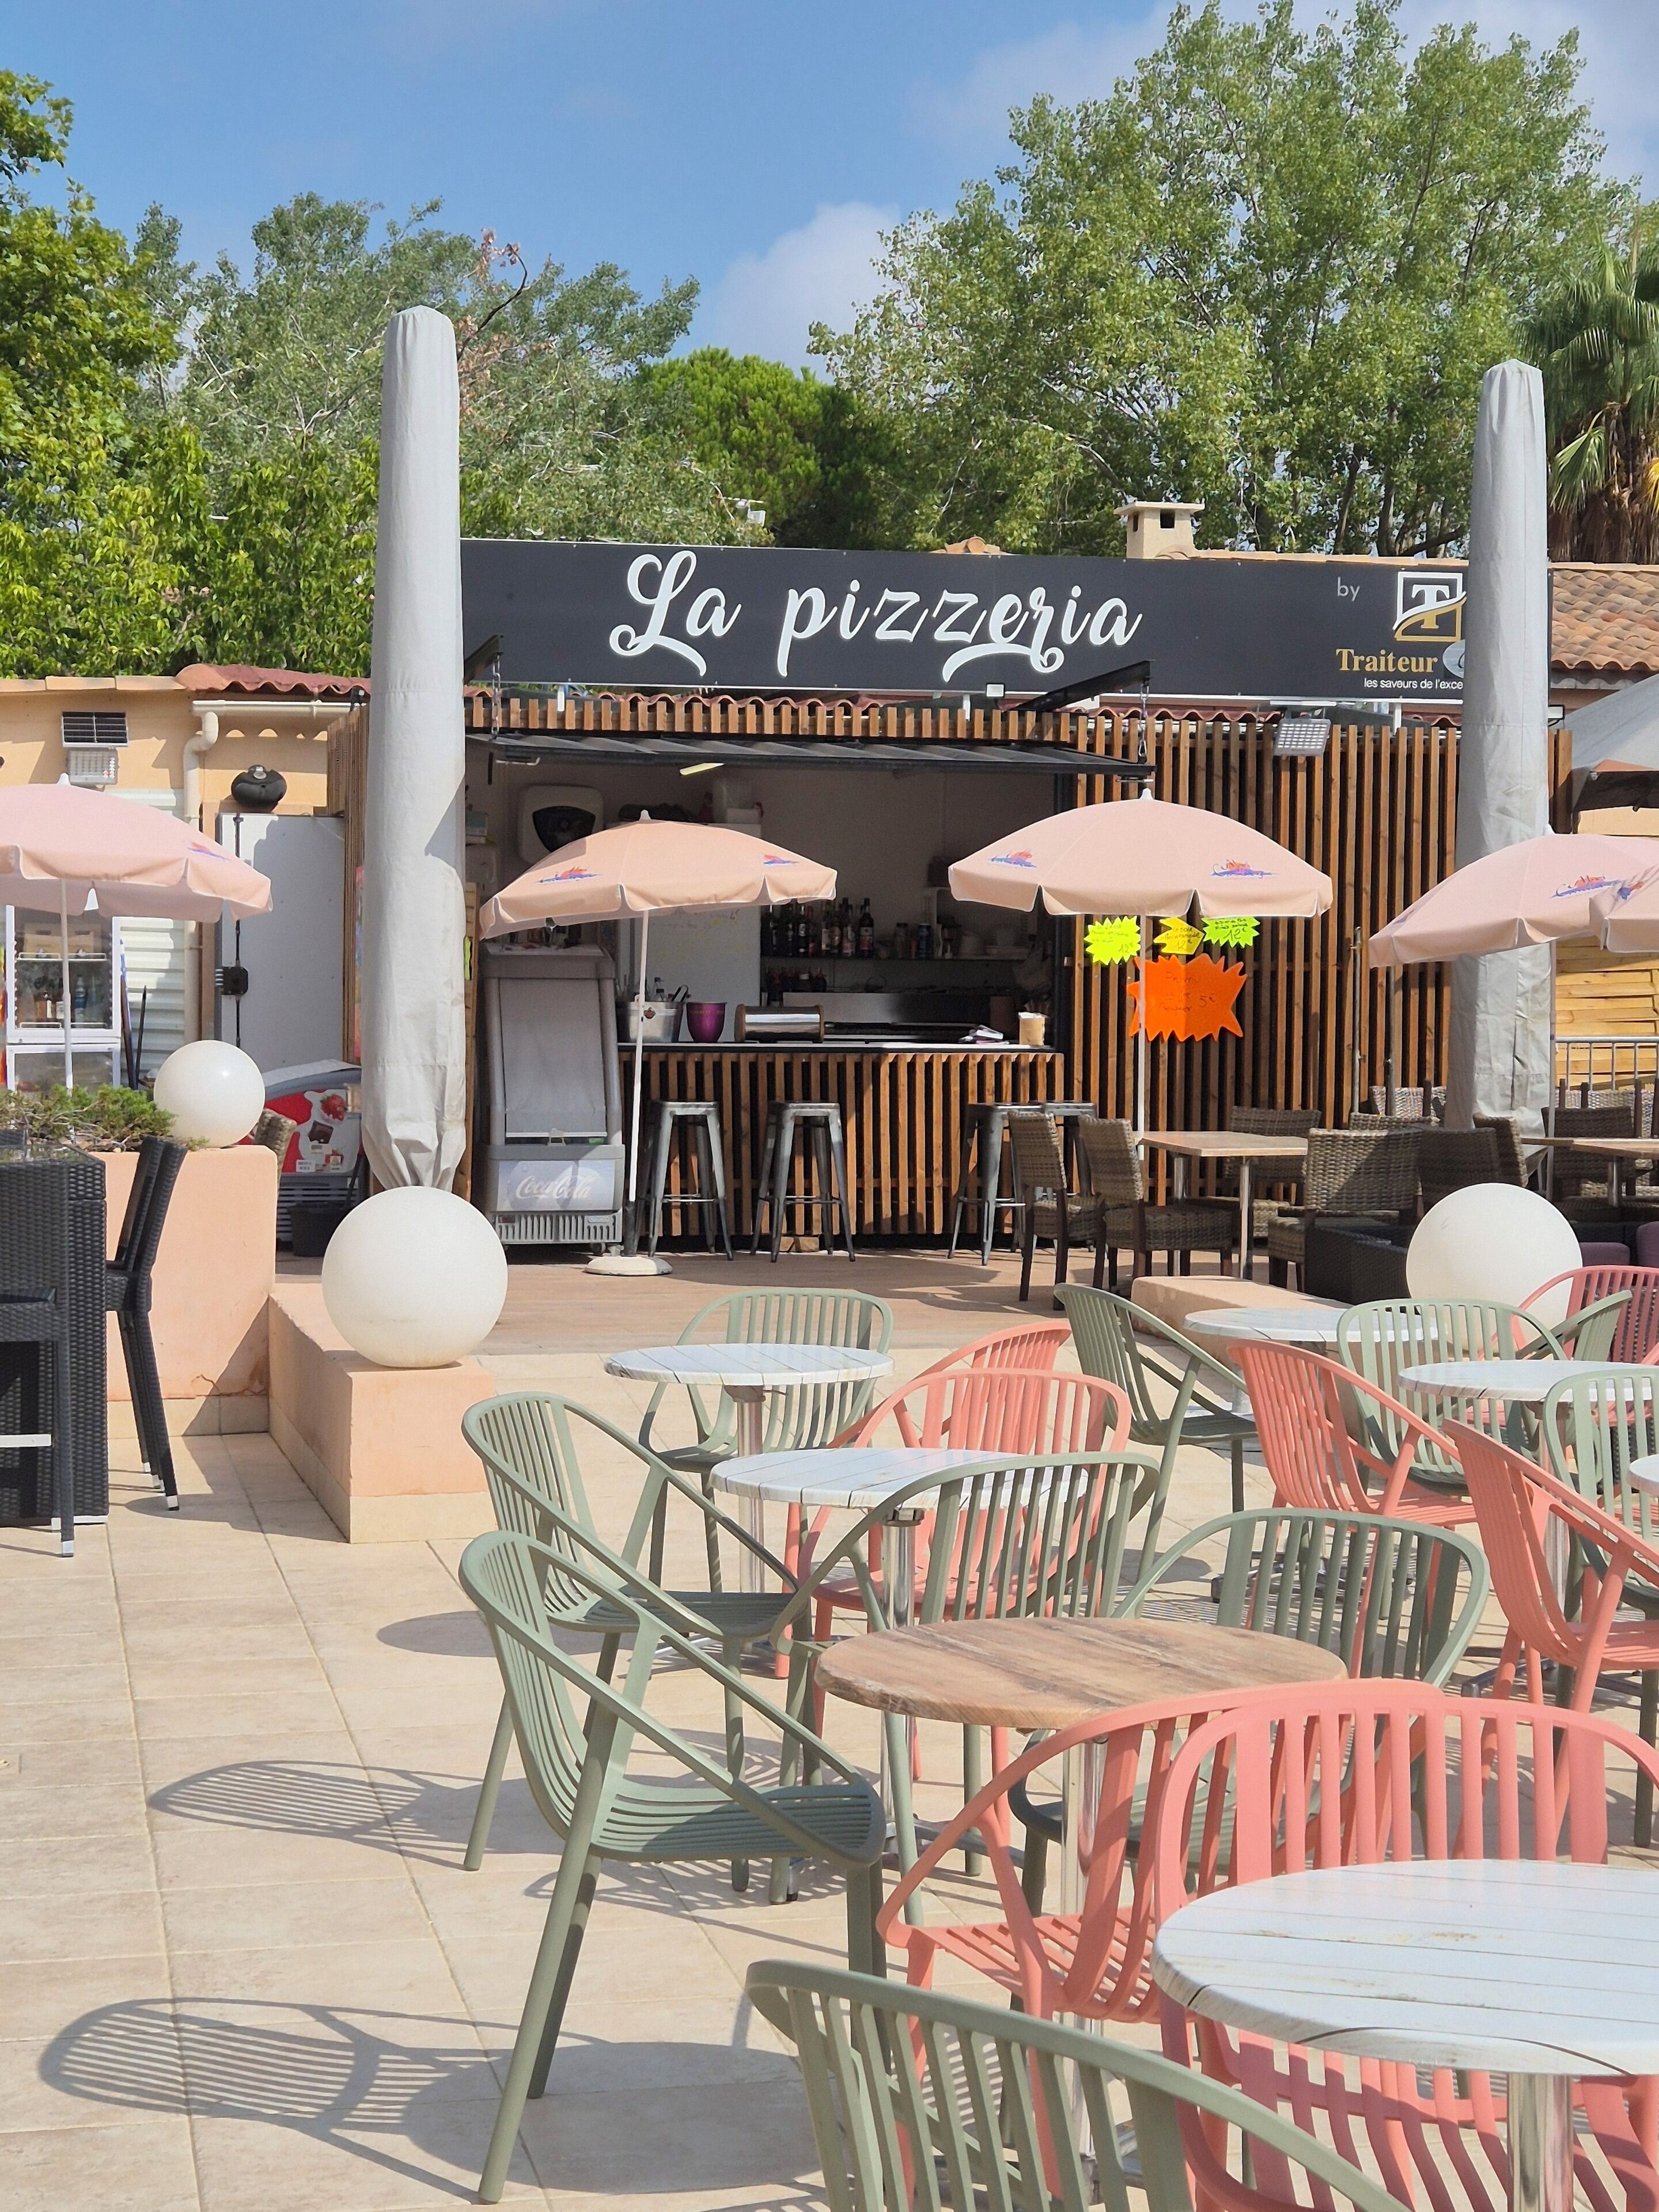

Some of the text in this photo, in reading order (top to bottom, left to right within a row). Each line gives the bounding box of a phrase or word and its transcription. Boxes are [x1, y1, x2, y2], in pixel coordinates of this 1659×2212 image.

[1336, 576, 1360, 601] by
[609, 550, 1143, 683] La pizzeria
[1335, 649, 1438, 673] Traiteur
[1364, 678, 1378, 688] les
[1380, 680, 1418, 689] saveurs
[1420, 679, 1433, 689] de
